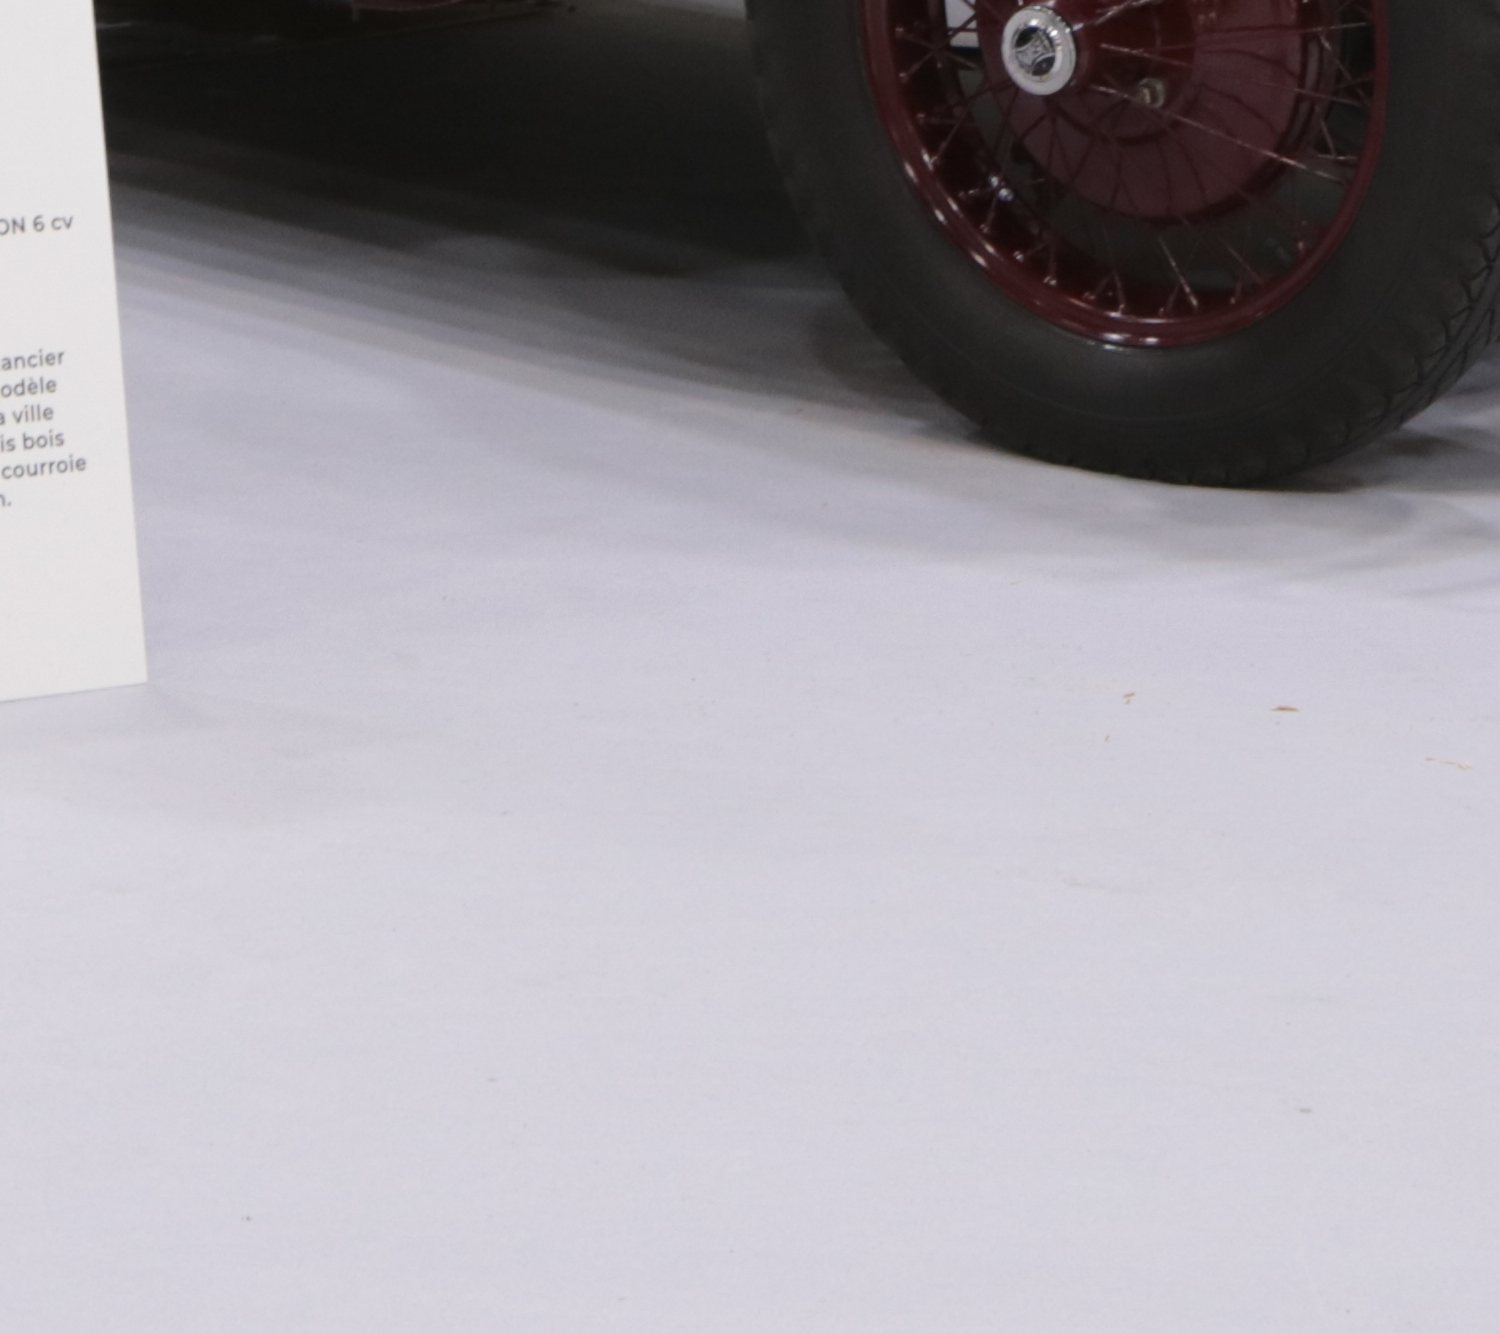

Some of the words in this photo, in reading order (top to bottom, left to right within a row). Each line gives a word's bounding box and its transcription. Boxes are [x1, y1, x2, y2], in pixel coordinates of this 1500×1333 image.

[33, 215, 44, 232] 6
[51, 217, 72, 230] cv
[13, 405, 53, 423] ville
[23, 433, 64, 449] bois
[2, 458, 86, 479] courroie
